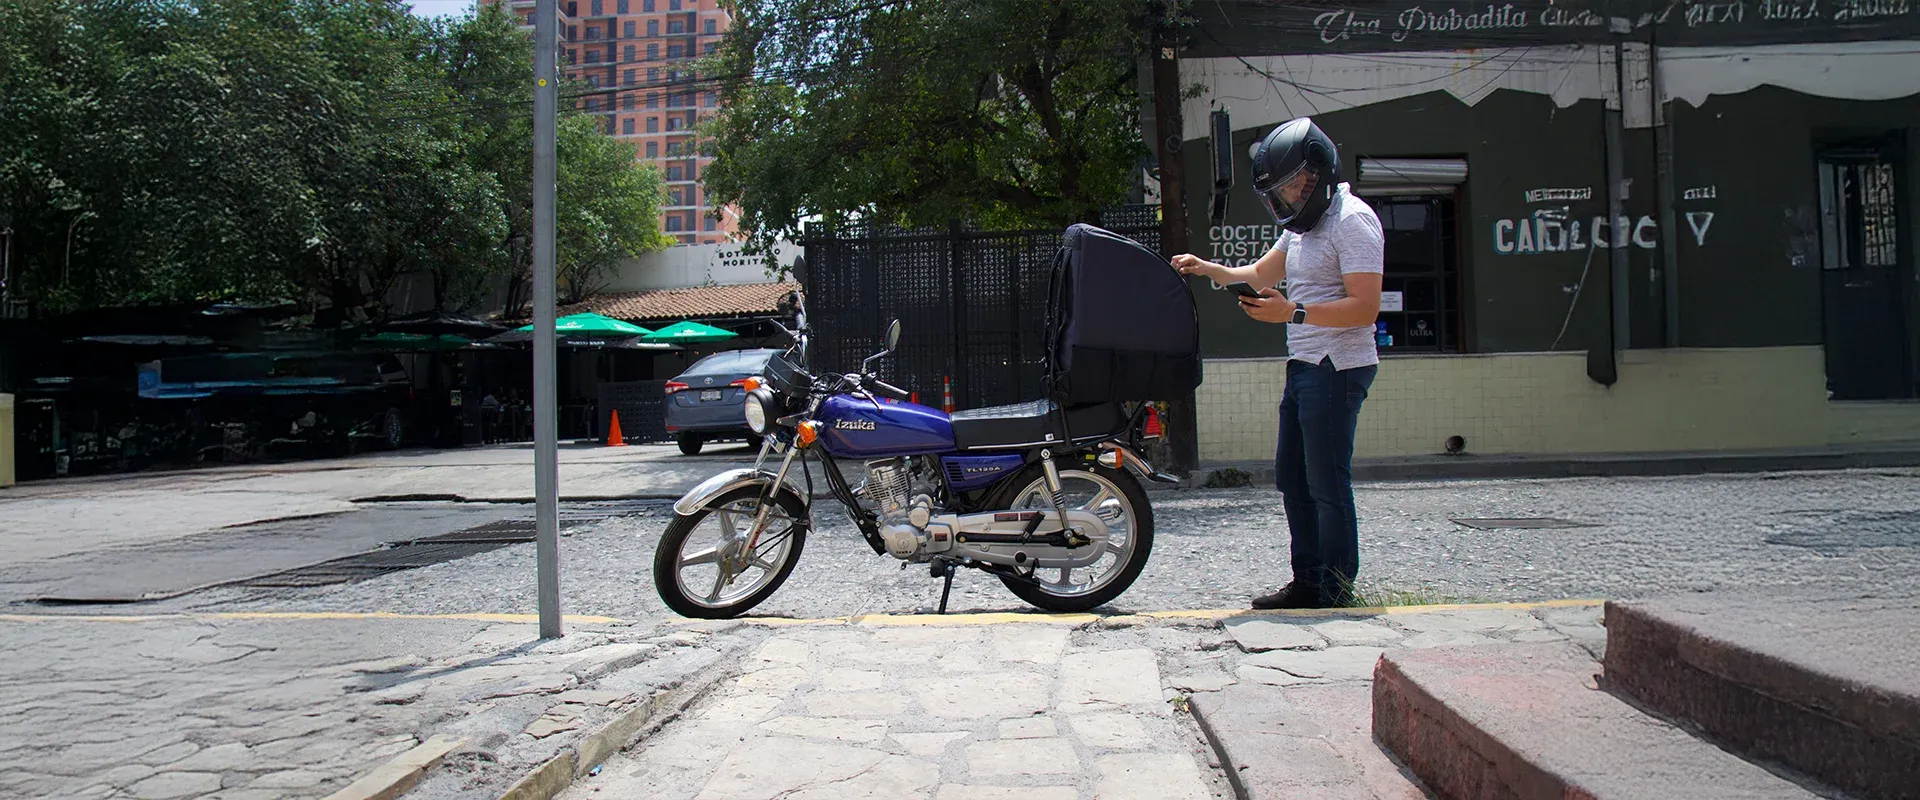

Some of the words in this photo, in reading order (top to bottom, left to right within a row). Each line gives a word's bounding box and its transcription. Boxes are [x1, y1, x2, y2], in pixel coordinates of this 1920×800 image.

[1391, 4, 1528, 42] Probadita
[718, 248, 781, 259] BOTAEO
[834, 418, 877, 430] Izuka
